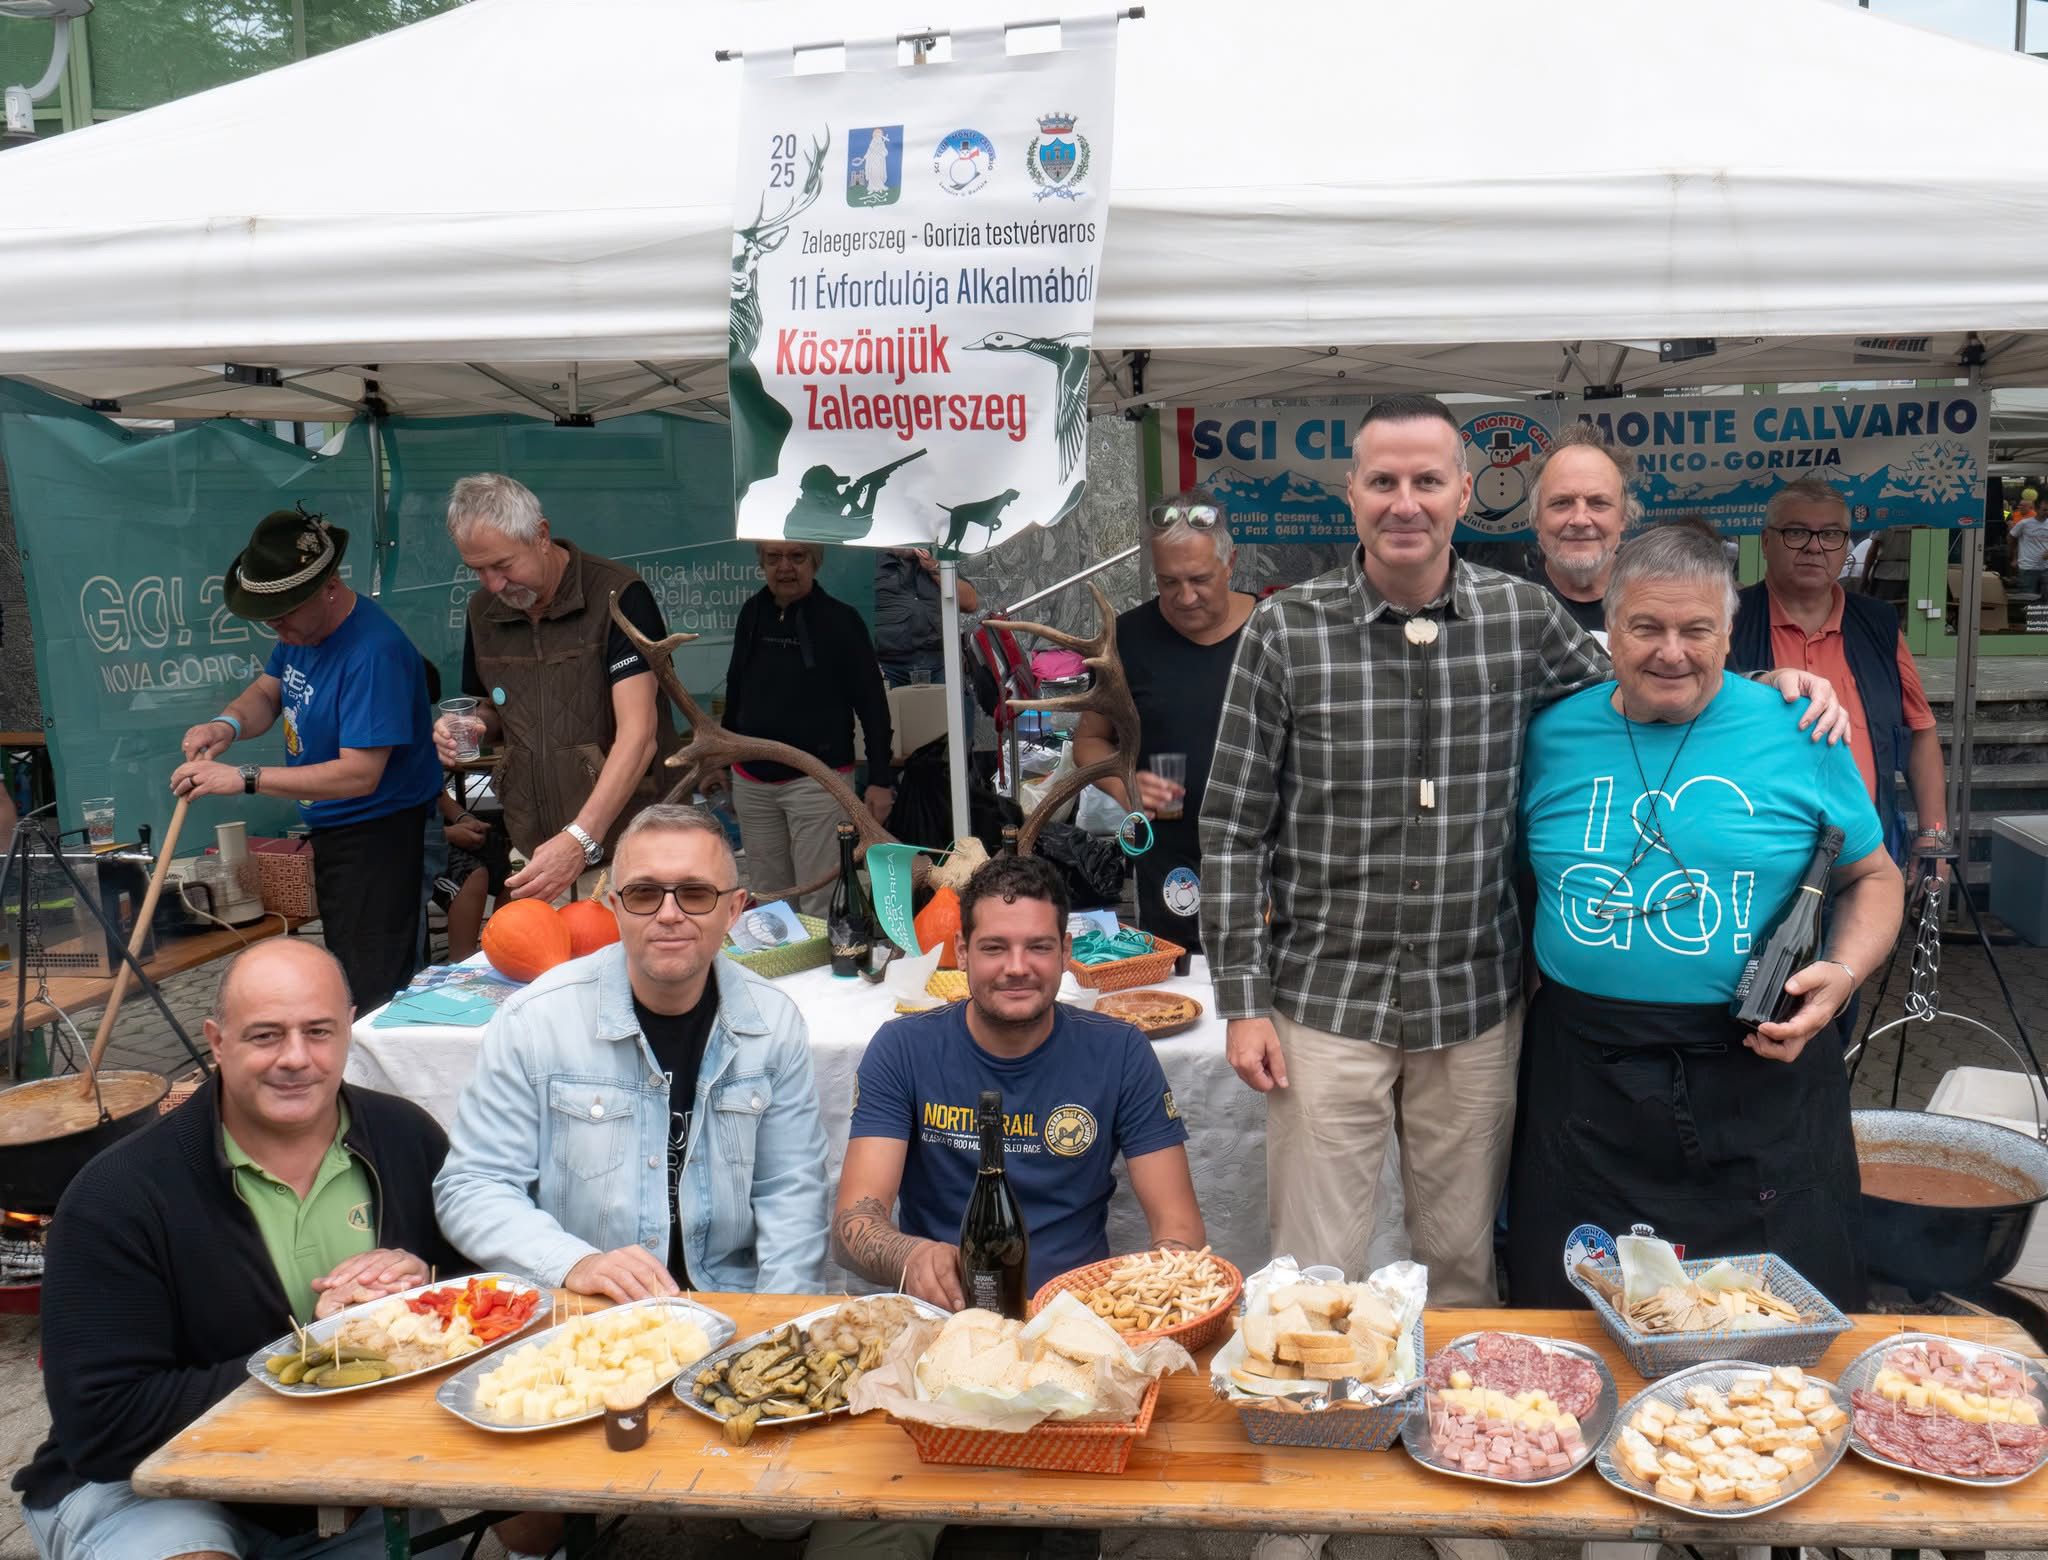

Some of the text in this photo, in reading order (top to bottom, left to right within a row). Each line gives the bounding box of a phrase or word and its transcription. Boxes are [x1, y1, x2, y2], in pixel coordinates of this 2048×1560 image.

[772, 135, 796, 160] 20
[770, 163, 795, 188] 25
[802, 229, 906, 255] Zalaegerszeg
[924, 222, 980, 248] Gorizia
[985, 221, 1095, 247] testvérvaros
[790, 265, 1093, 313] 11 Évfordulója Alkalmából
[776, 324, 951, 385] Köszönjük
[804, 385, 1027, 441] Zalaegerszeg
[1193, 419, 1277, 461] SCI
[1295, 419, 1354, 461] CL
[1577, 409, 1736, 447] MONTE
[1753, 399, 1978, 444] CALVARIO
[1474, 415, 1526, 433] MONTE
[1637, 447, 1841, 473] NICO-GORIZIA
[80, 575, 192, 653] GO!
[101, 661, 156, 693] NOVA
[1584, 776, 1613, 852] I
[1559, 863, 1755, 955] GO!
[1002, 1113, 1039, 1137] RAIL
[953, 1139, 968, 1150] 800
[968, 1141, 981, 1151] MIL
